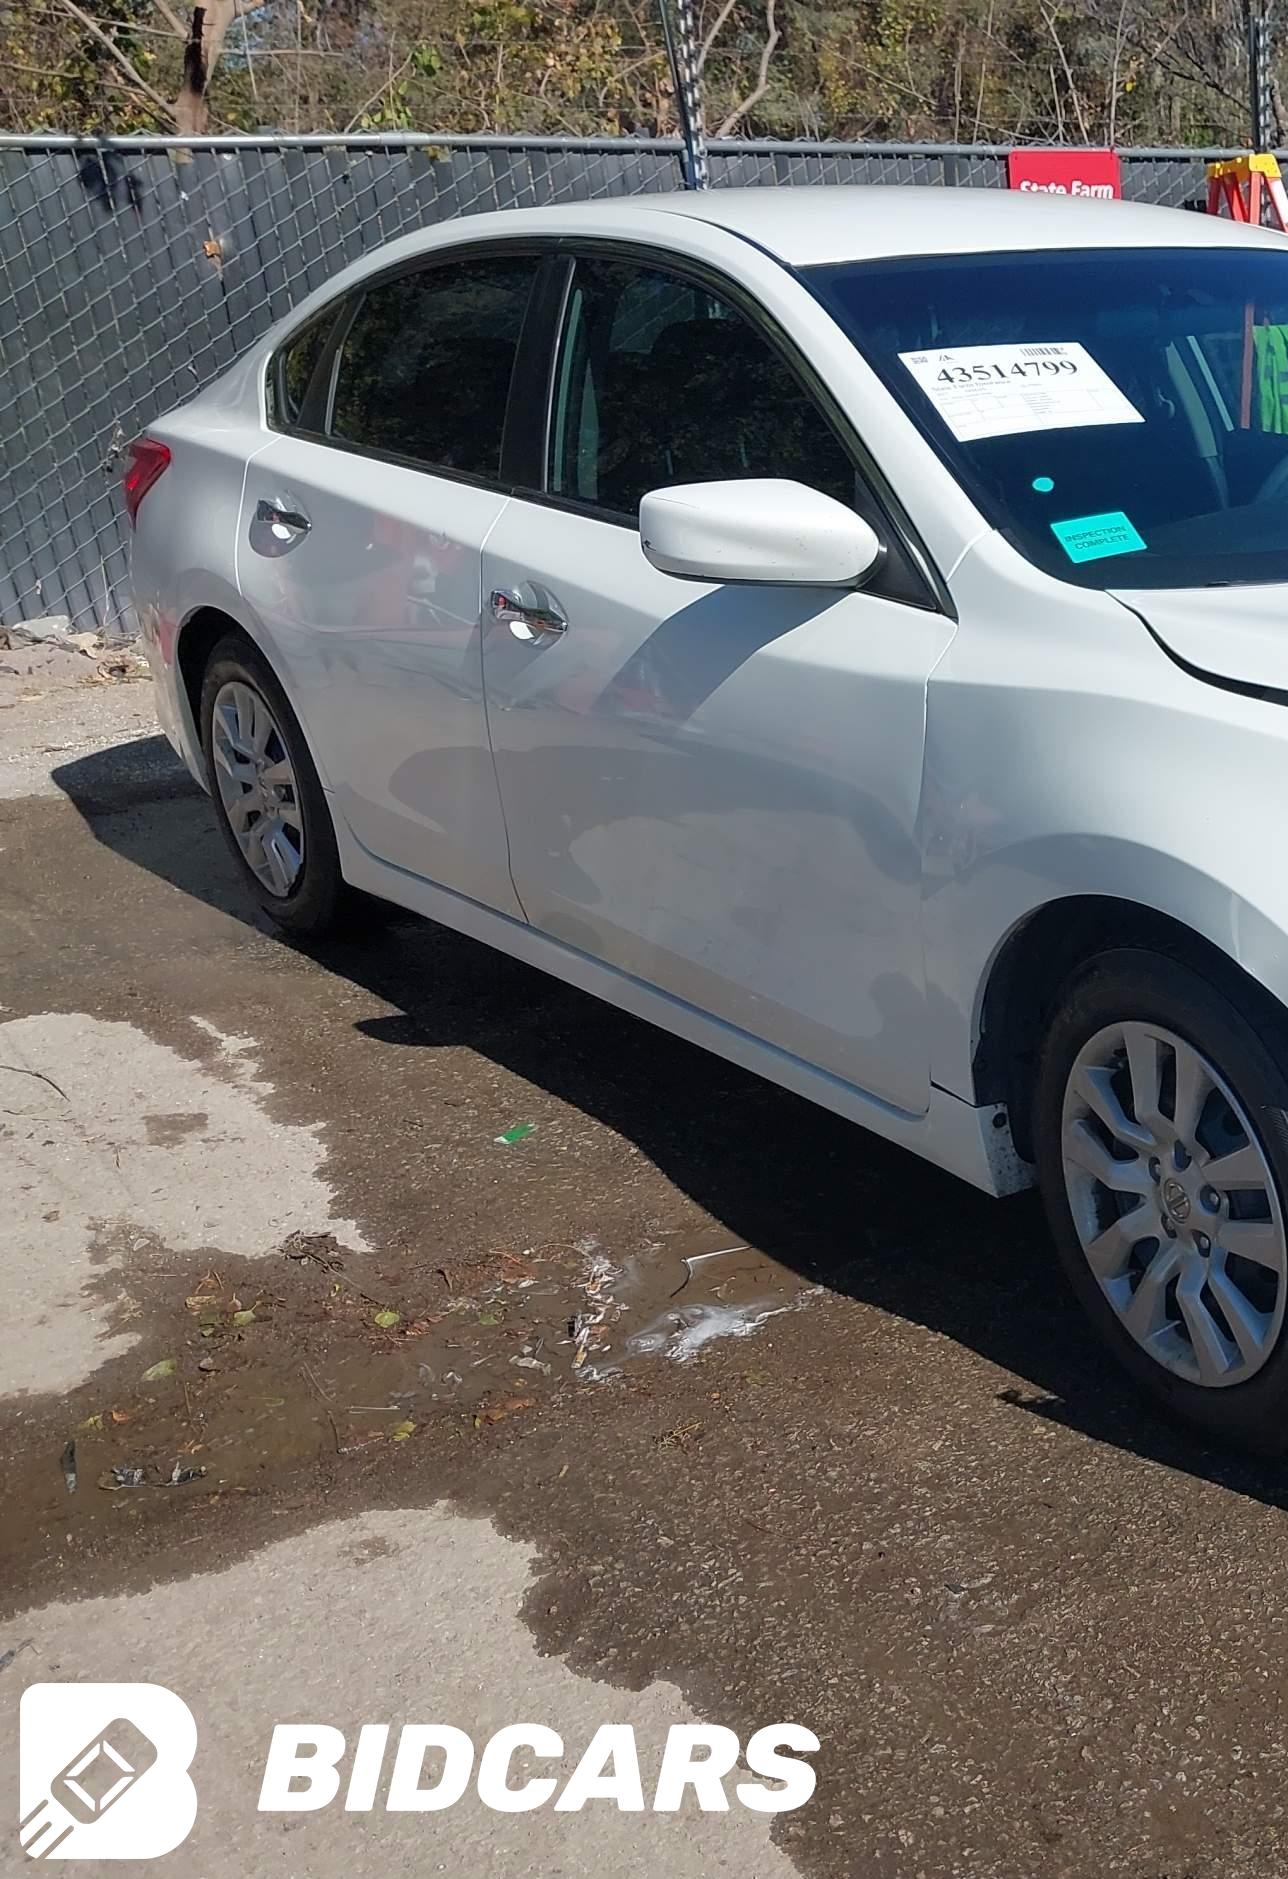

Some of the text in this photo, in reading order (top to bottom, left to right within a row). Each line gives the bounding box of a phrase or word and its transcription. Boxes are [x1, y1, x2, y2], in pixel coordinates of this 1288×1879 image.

[1071, 180, 1114, 199] Farm
[937, 360, 1078, 383] 43514799
[1064, 525, 1127, 543] INSPECTION
[1075, 533, 1129, 550] COMPLETE
